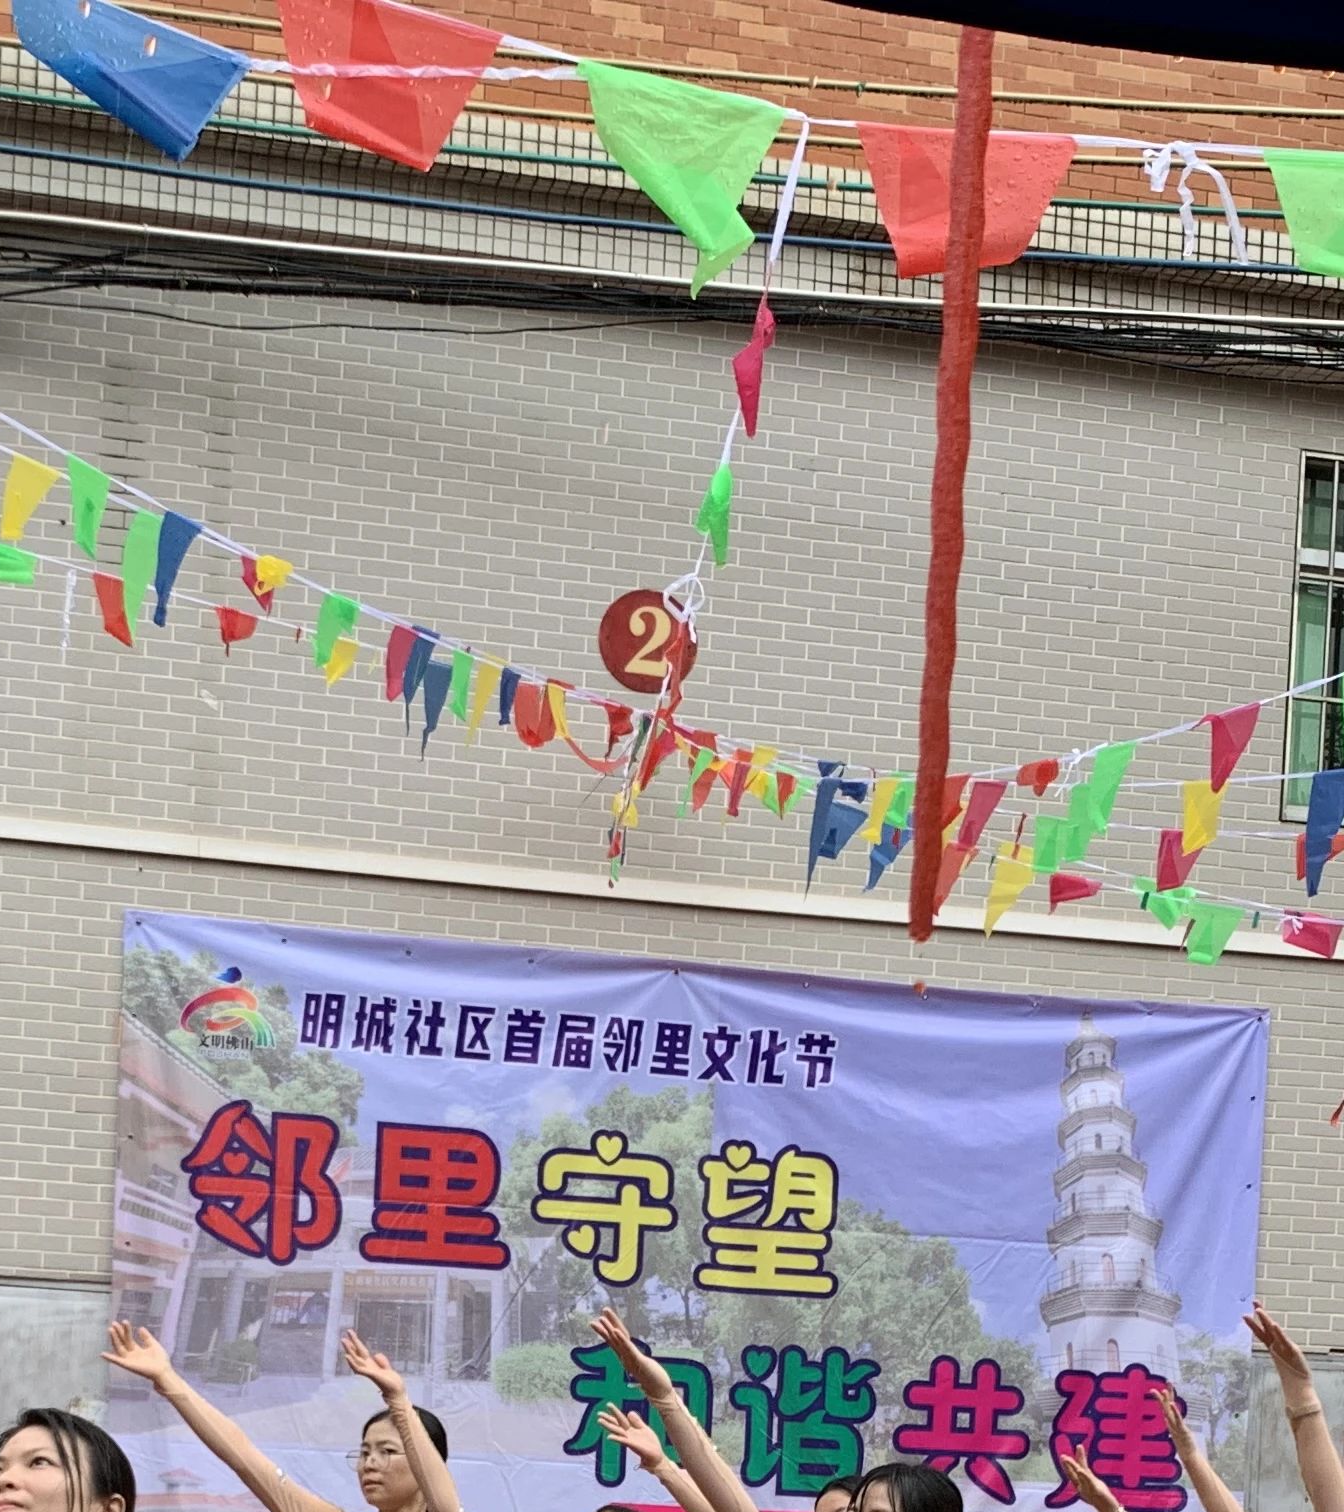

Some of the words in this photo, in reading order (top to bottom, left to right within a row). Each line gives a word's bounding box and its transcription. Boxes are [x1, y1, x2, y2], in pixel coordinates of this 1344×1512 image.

[624, 606, 671, 677] 2
[301, 992, 838, 1089] 明城社区首届邻里文化节
[181, 1100, 839, 1298] 邻里守望
